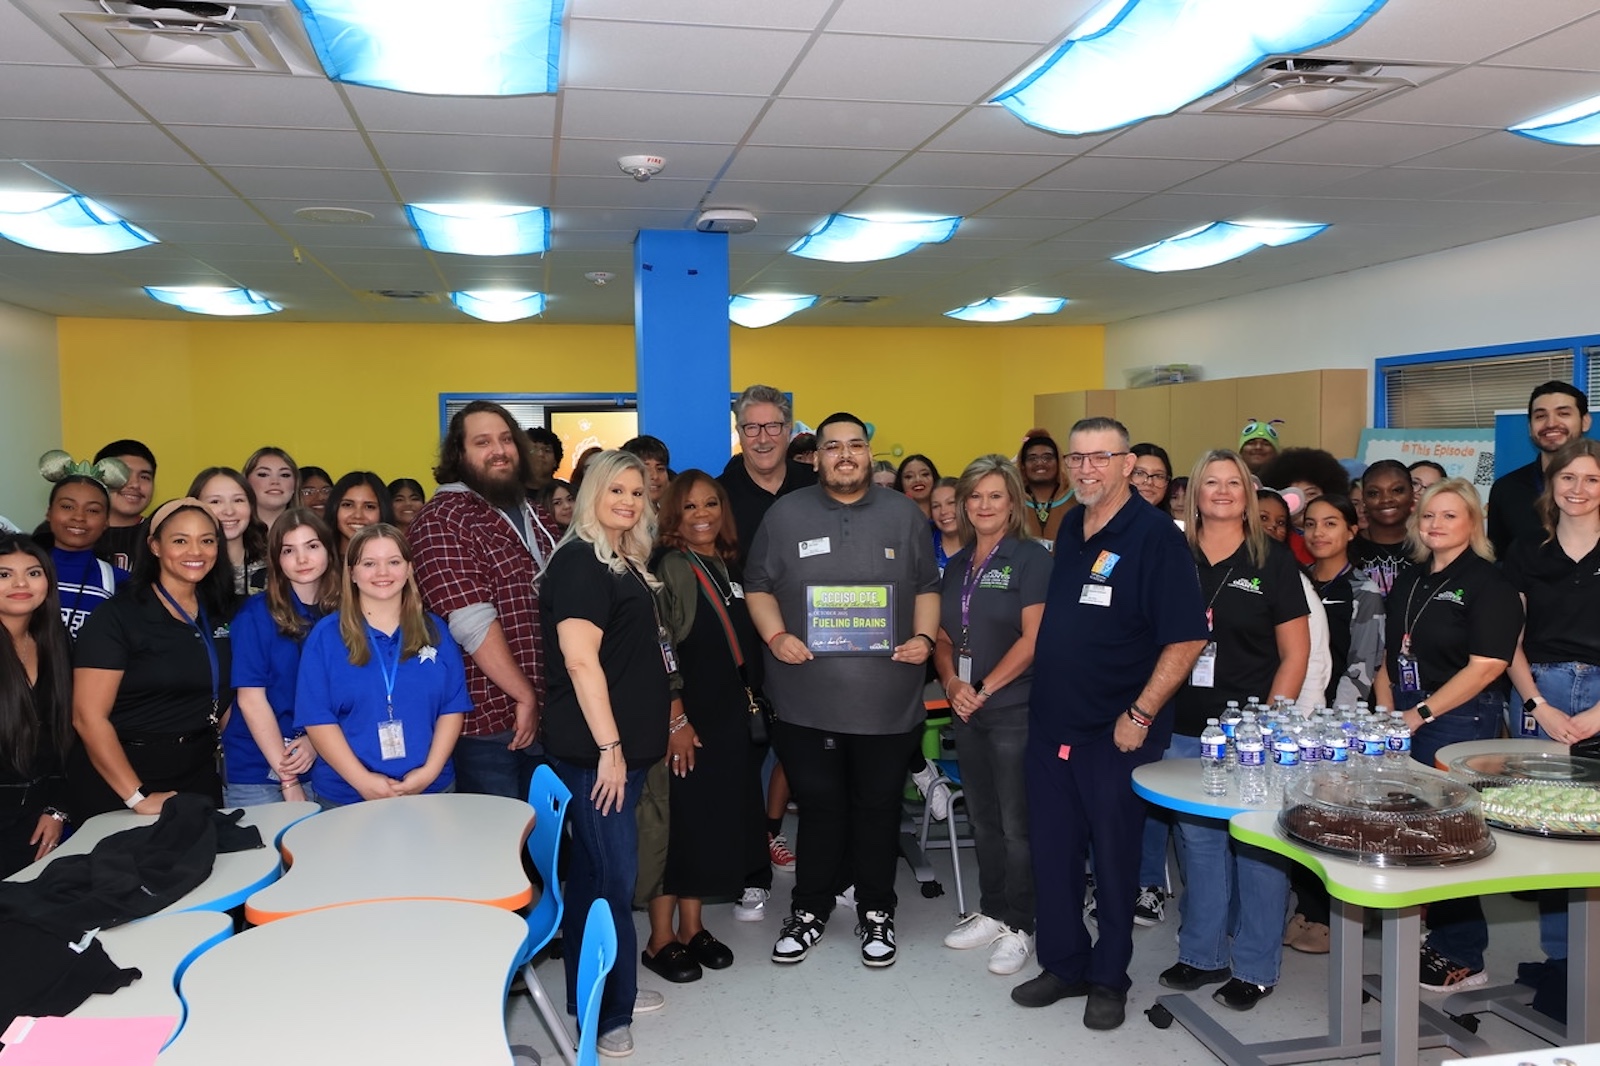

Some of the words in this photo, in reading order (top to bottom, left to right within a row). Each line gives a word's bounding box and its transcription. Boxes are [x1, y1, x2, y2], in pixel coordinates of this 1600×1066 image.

[1412, 443, 1431, 456] This
[1433, 444, 1475, 457] Episode
[859, 592, 877, 603] CTE
